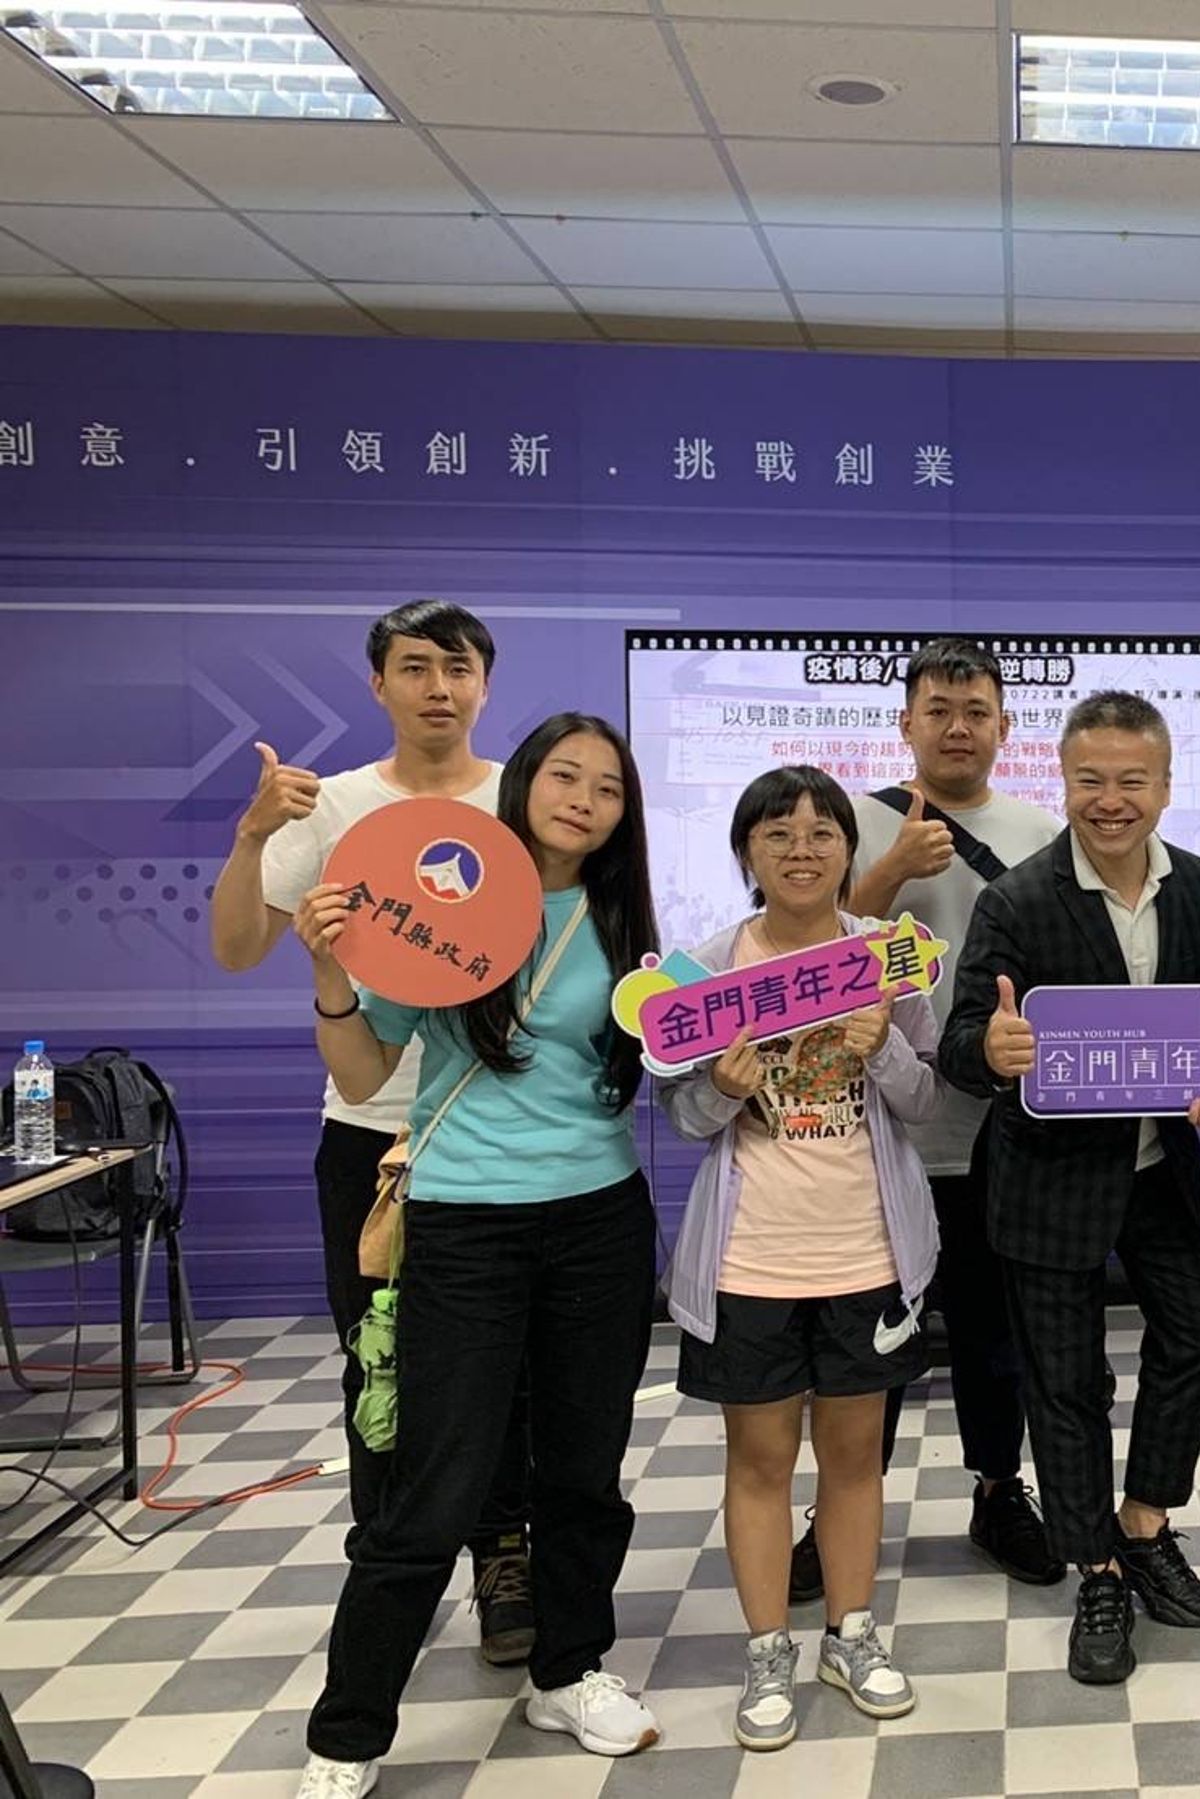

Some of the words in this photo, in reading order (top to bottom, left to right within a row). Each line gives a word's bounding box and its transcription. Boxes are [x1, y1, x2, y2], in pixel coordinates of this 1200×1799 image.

[337, 881, 493, 982] 金門縣政府
[657, 936, 923, 1050] 金門青年之星
[1083, 1030, 1120, 1039] YOUTH
[1123, 1029, 1147, 1038] HUB
